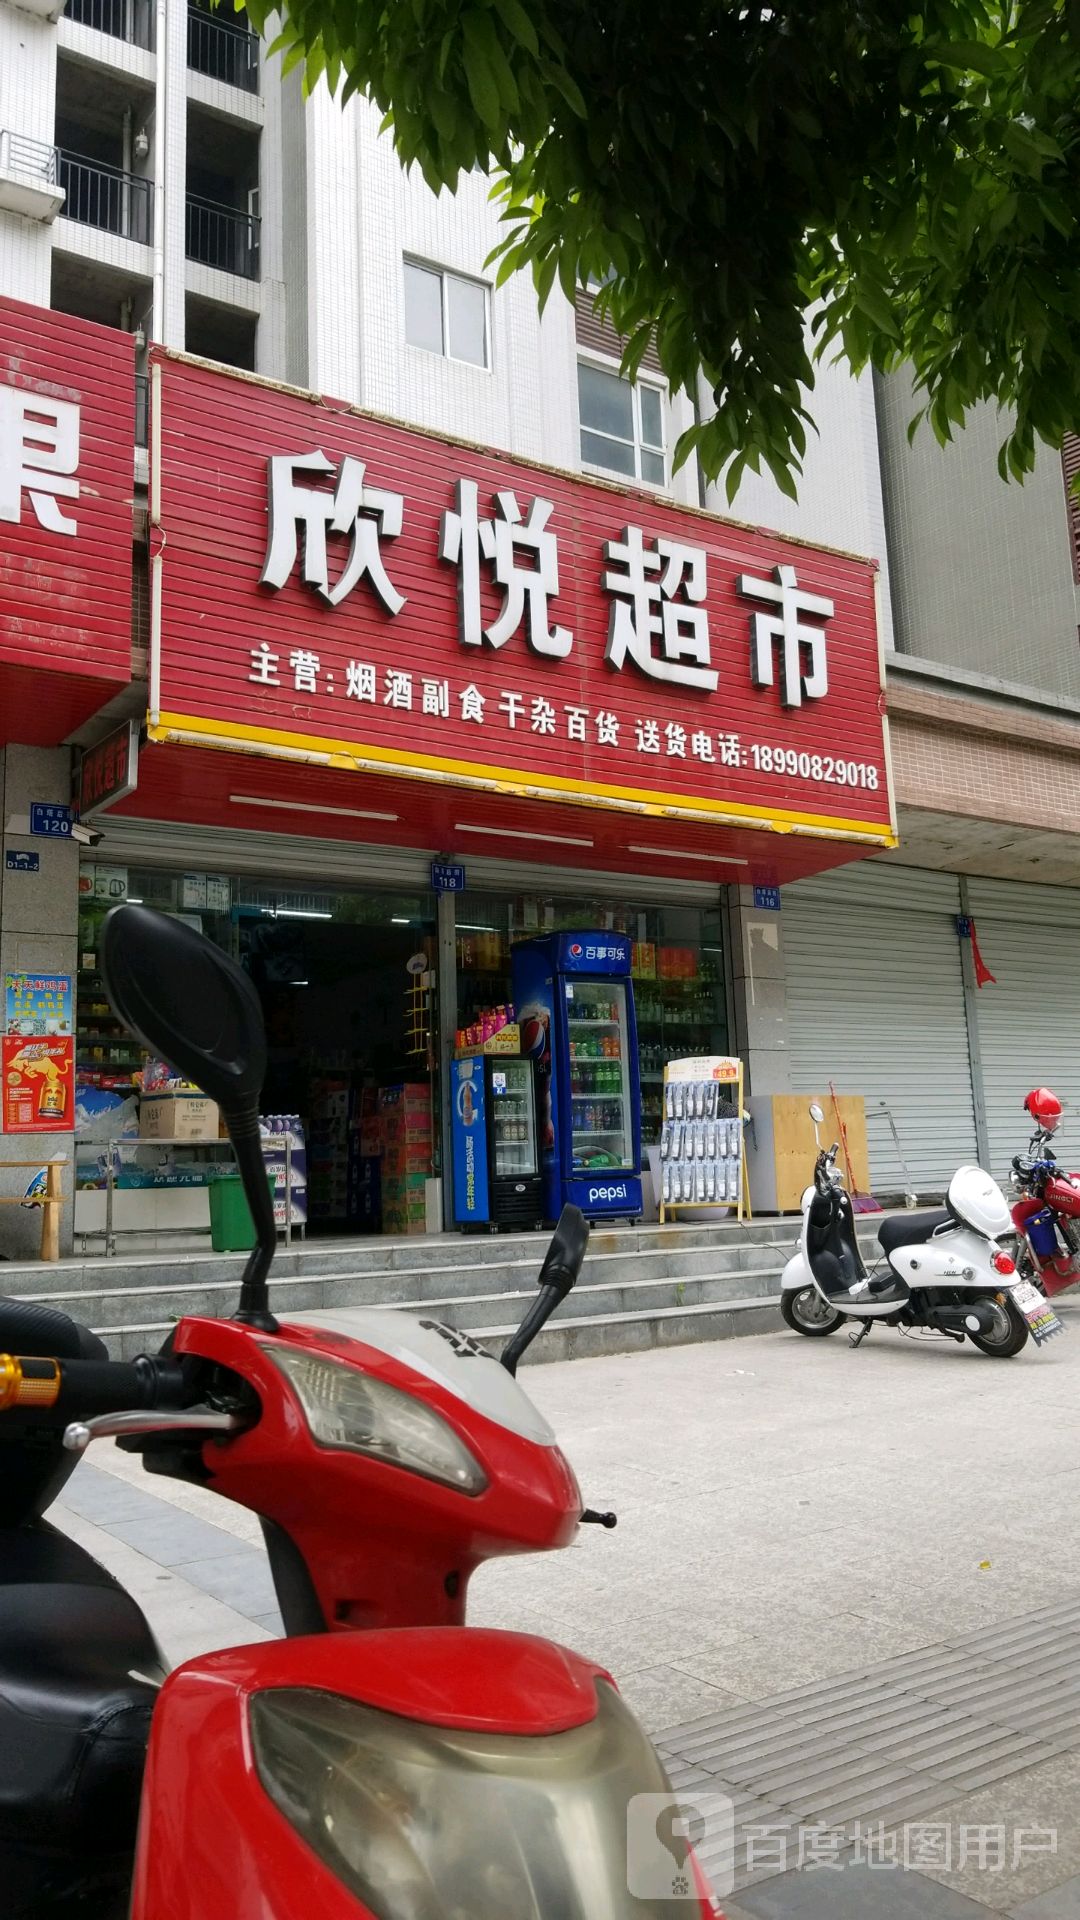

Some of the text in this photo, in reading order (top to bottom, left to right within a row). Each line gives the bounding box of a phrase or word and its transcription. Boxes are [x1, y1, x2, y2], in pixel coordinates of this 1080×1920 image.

[259, 449, 835, 709] 欣悦超市
[42, 819, 69, 833] 120
[7, 860, 39, 870] D1-1-2
[439, 876, 456, 888] 118
[760, 896, 775, 907] 116
[585, 945, 626, 961] 百事可乐
[589, 1183, 627, 1203] pepsi
